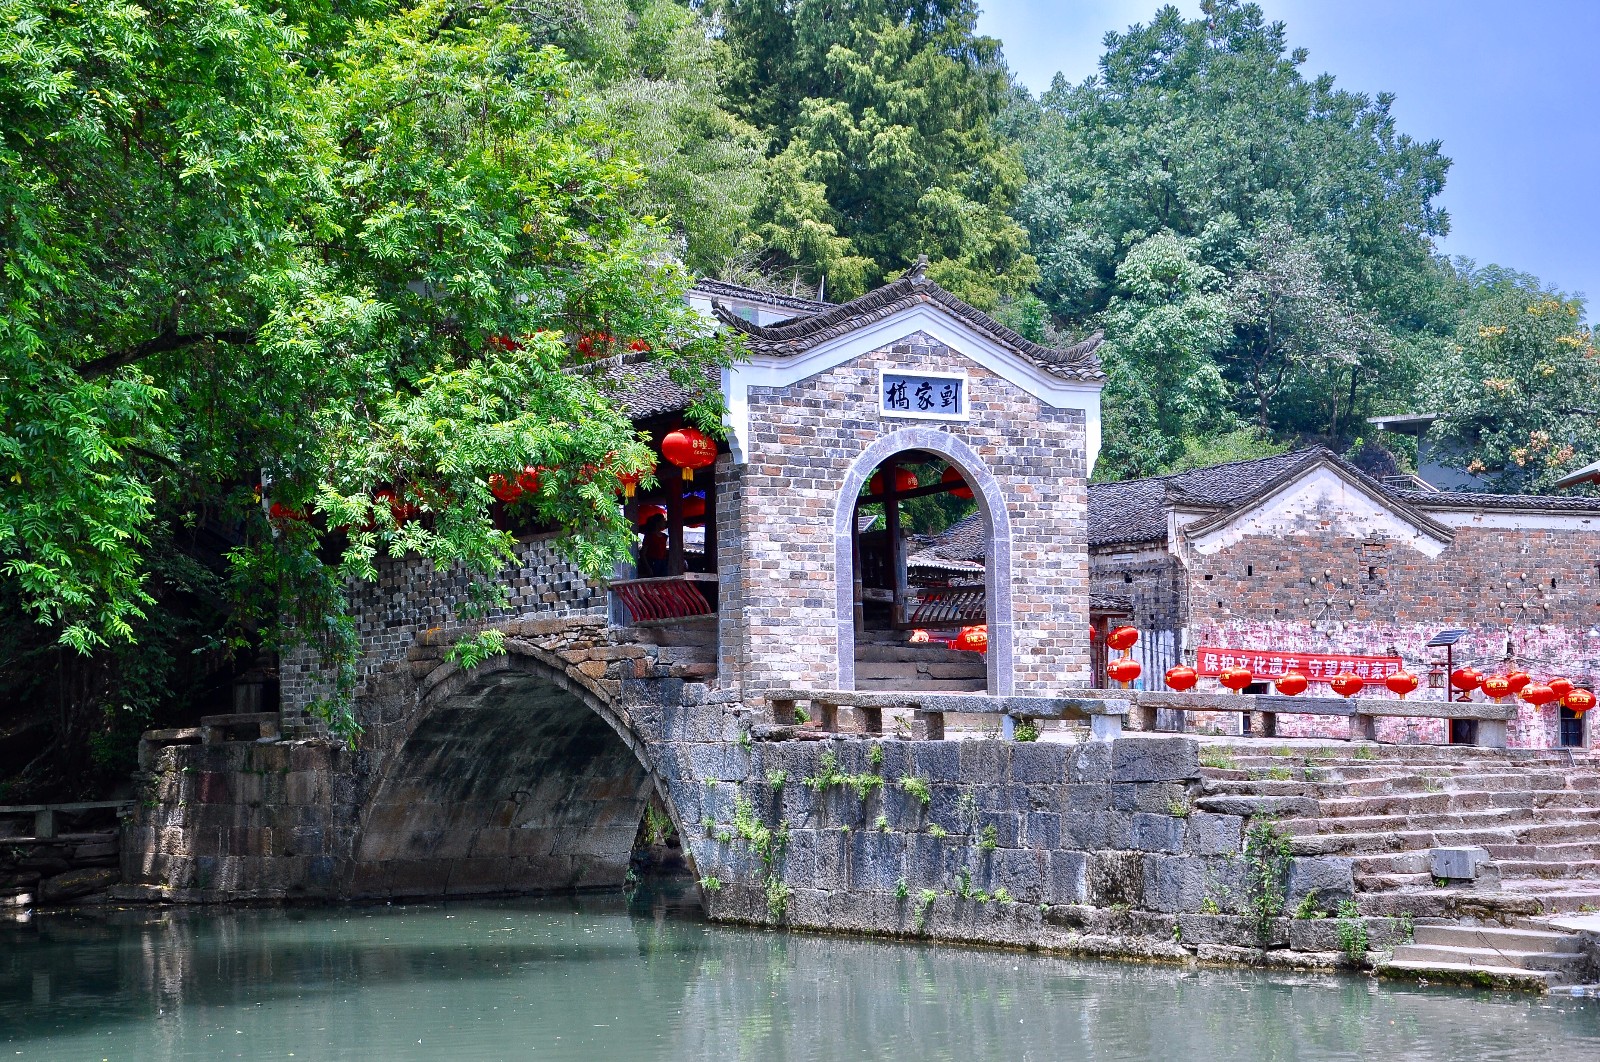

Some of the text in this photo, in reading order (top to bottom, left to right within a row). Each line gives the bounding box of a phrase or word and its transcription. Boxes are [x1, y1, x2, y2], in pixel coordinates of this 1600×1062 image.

[1203, 652, 1399, 680] 保护文化遗产 守望精神家园
